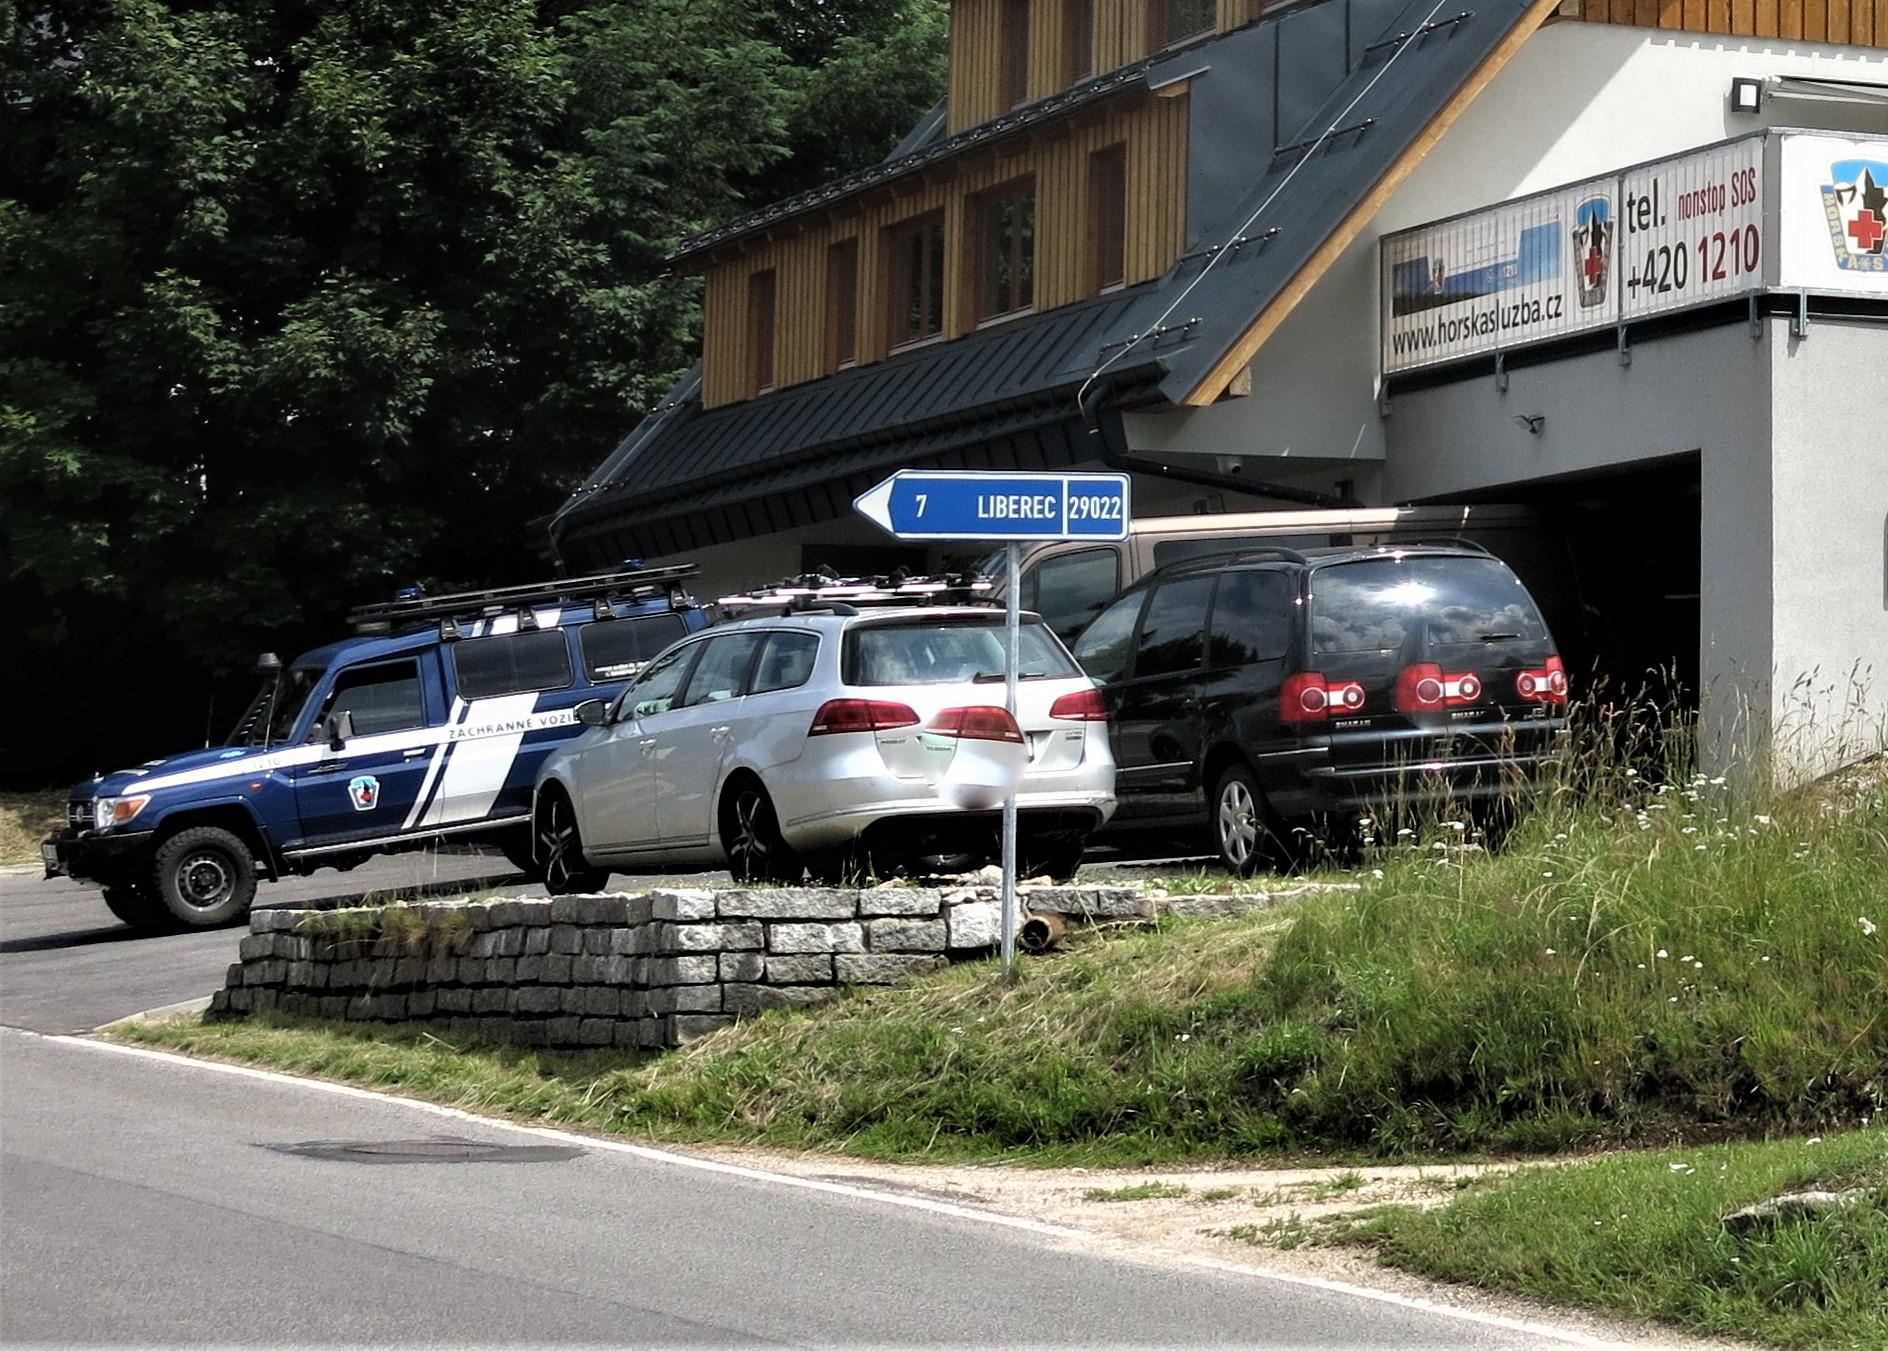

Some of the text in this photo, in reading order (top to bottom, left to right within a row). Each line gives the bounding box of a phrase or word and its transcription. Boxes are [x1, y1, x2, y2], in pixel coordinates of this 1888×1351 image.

[1627, 167, 1756, 234] tel. nonstop SOS
[1627, 224, 1760, 299] +420 1210
[1393, 293, 1563, 356] www.horskasluzba.cz
[915, 494, 1121, 519] 7 LIBEREC 29022
